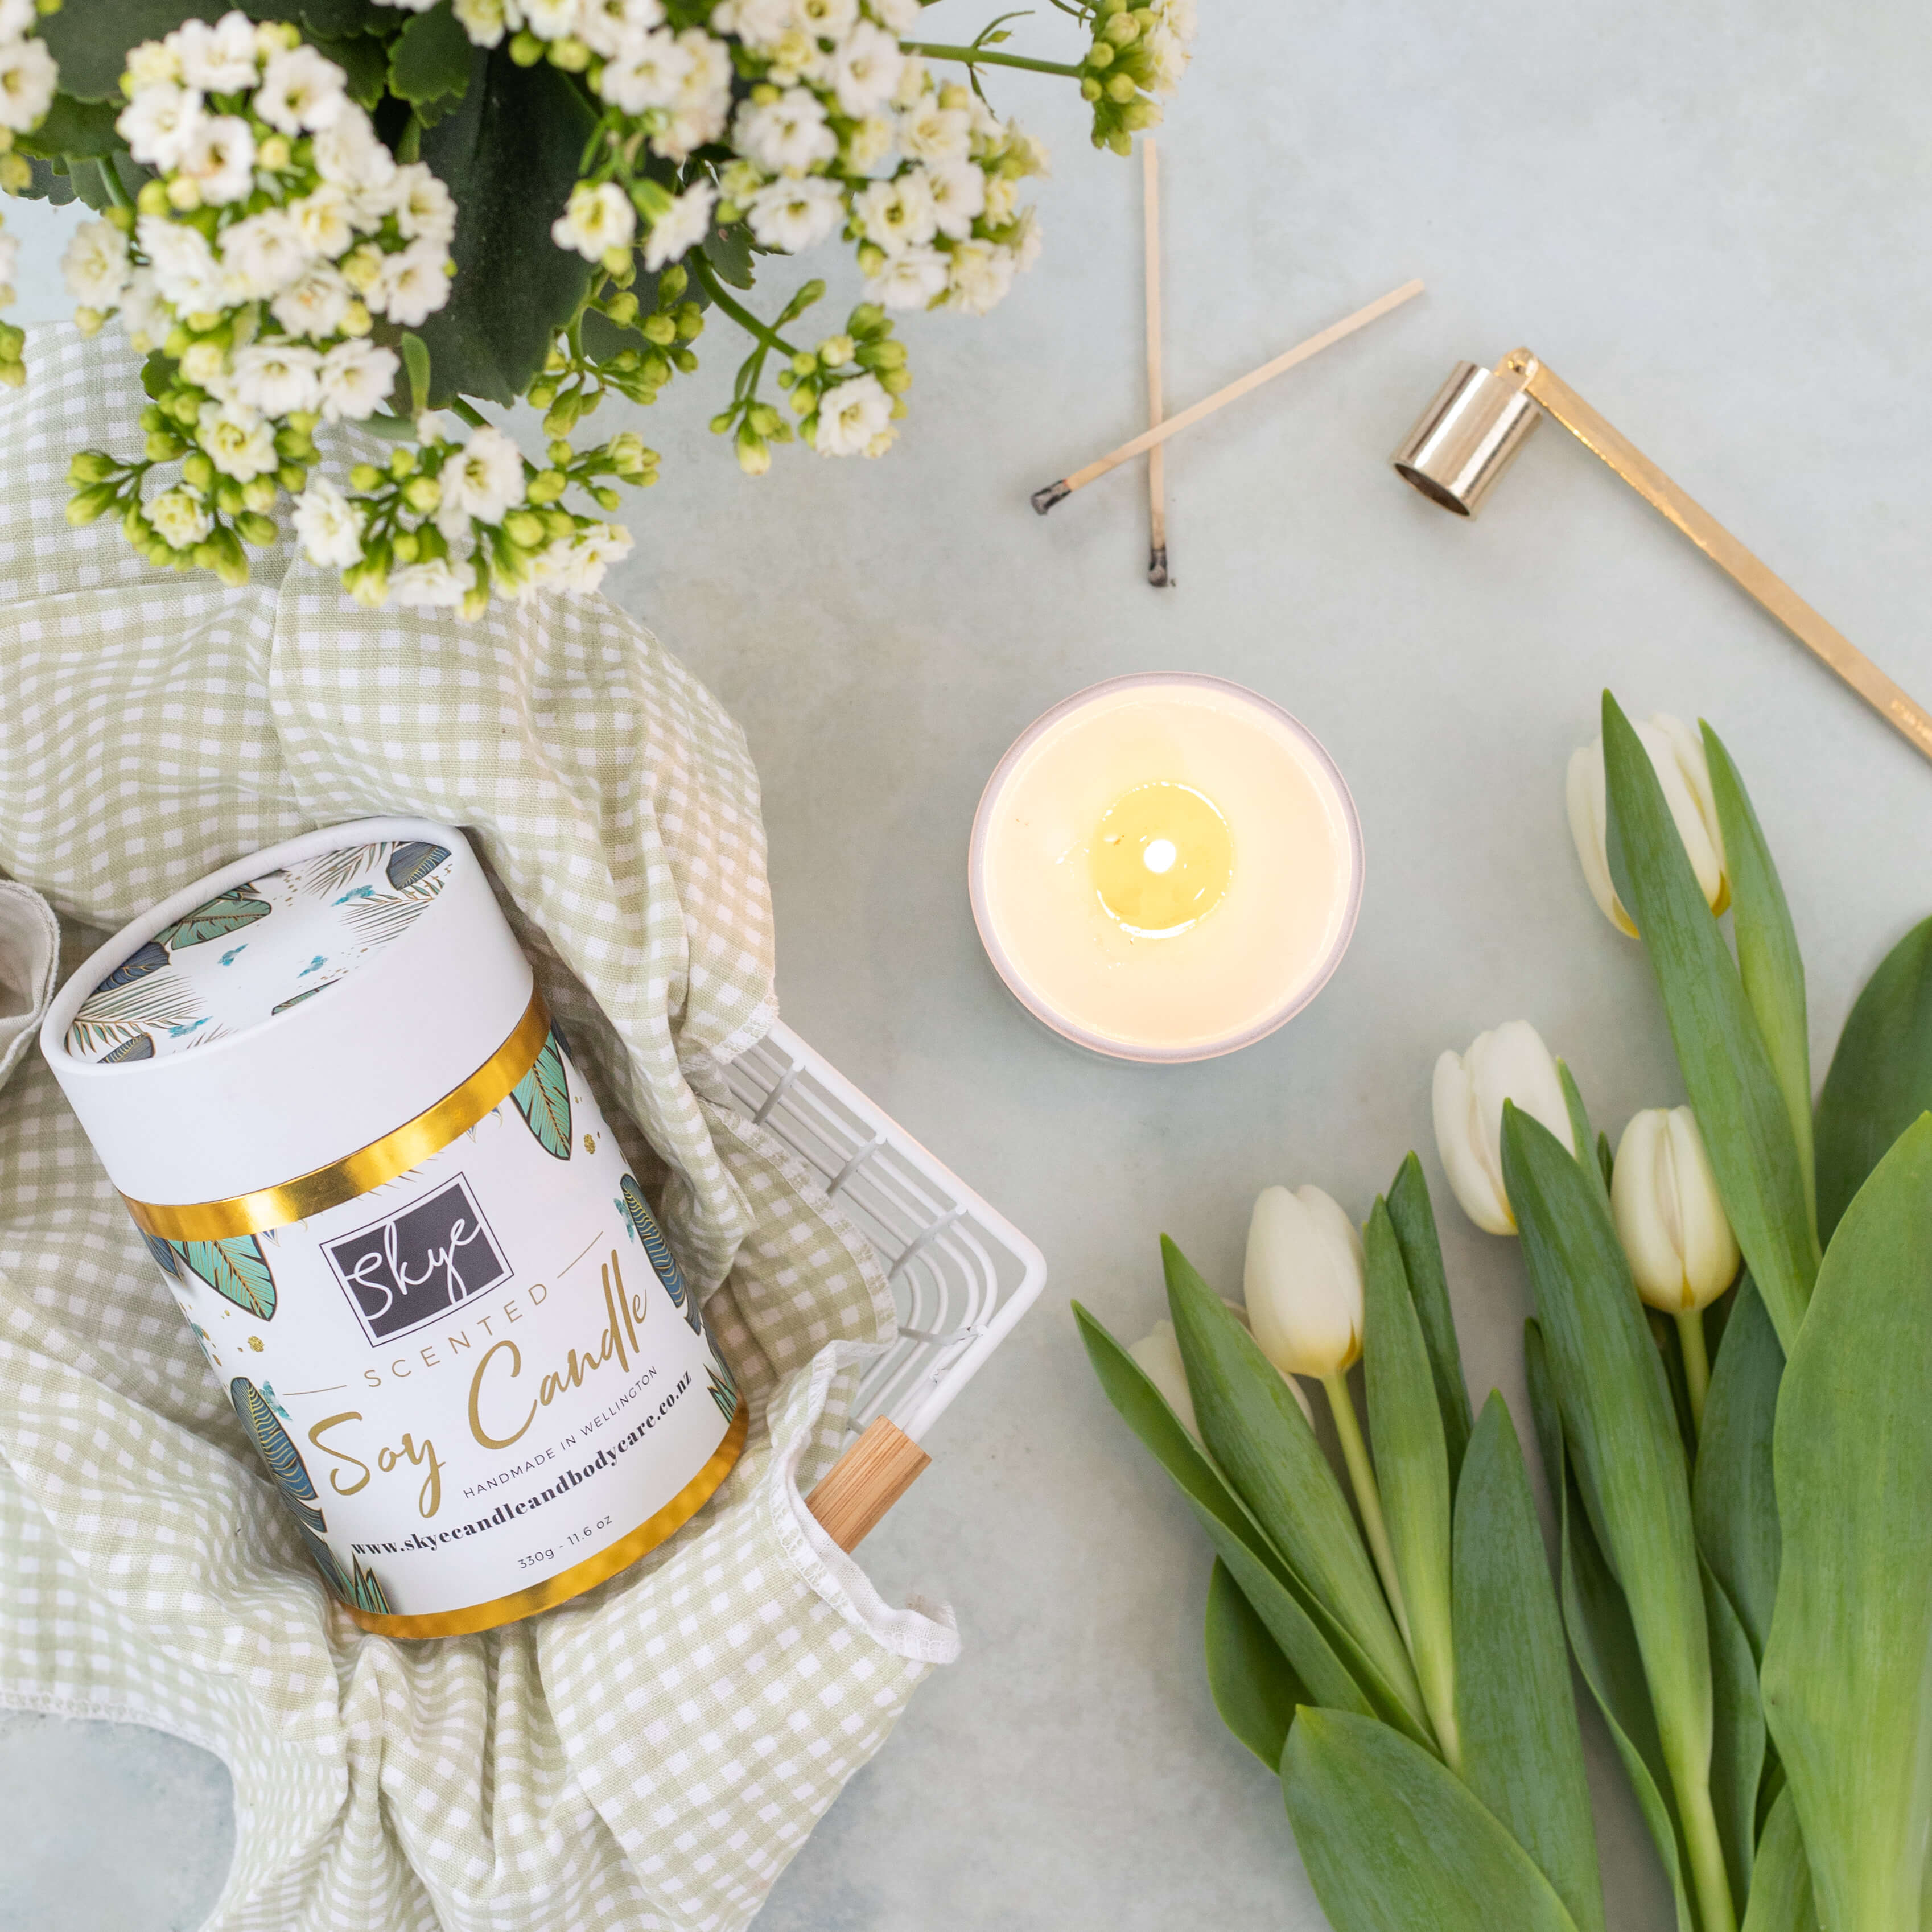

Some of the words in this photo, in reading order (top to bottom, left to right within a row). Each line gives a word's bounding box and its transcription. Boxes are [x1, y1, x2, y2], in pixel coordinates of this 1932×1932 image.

[346, 1218, 481, 1320] Skye
[308, 1411, 446, 1518] Soy
[468, 1250, 647, 1449] Candle
[365, 1283, 547, 1387] SCENTED
[351, 1371, 693, 1555] www.skyecandleandbodycare.co.nz
[463, 1450, 555, 1498] HANDMADE
[561, 1435, 576, 1449] IN
[580, 1366, 657, 1435] WELLINGTON
[518, 1548, 555, 1569] 330g
[567, 1526, 592, 1544] 11.6
[596, 1515, 613, 1529] oz
